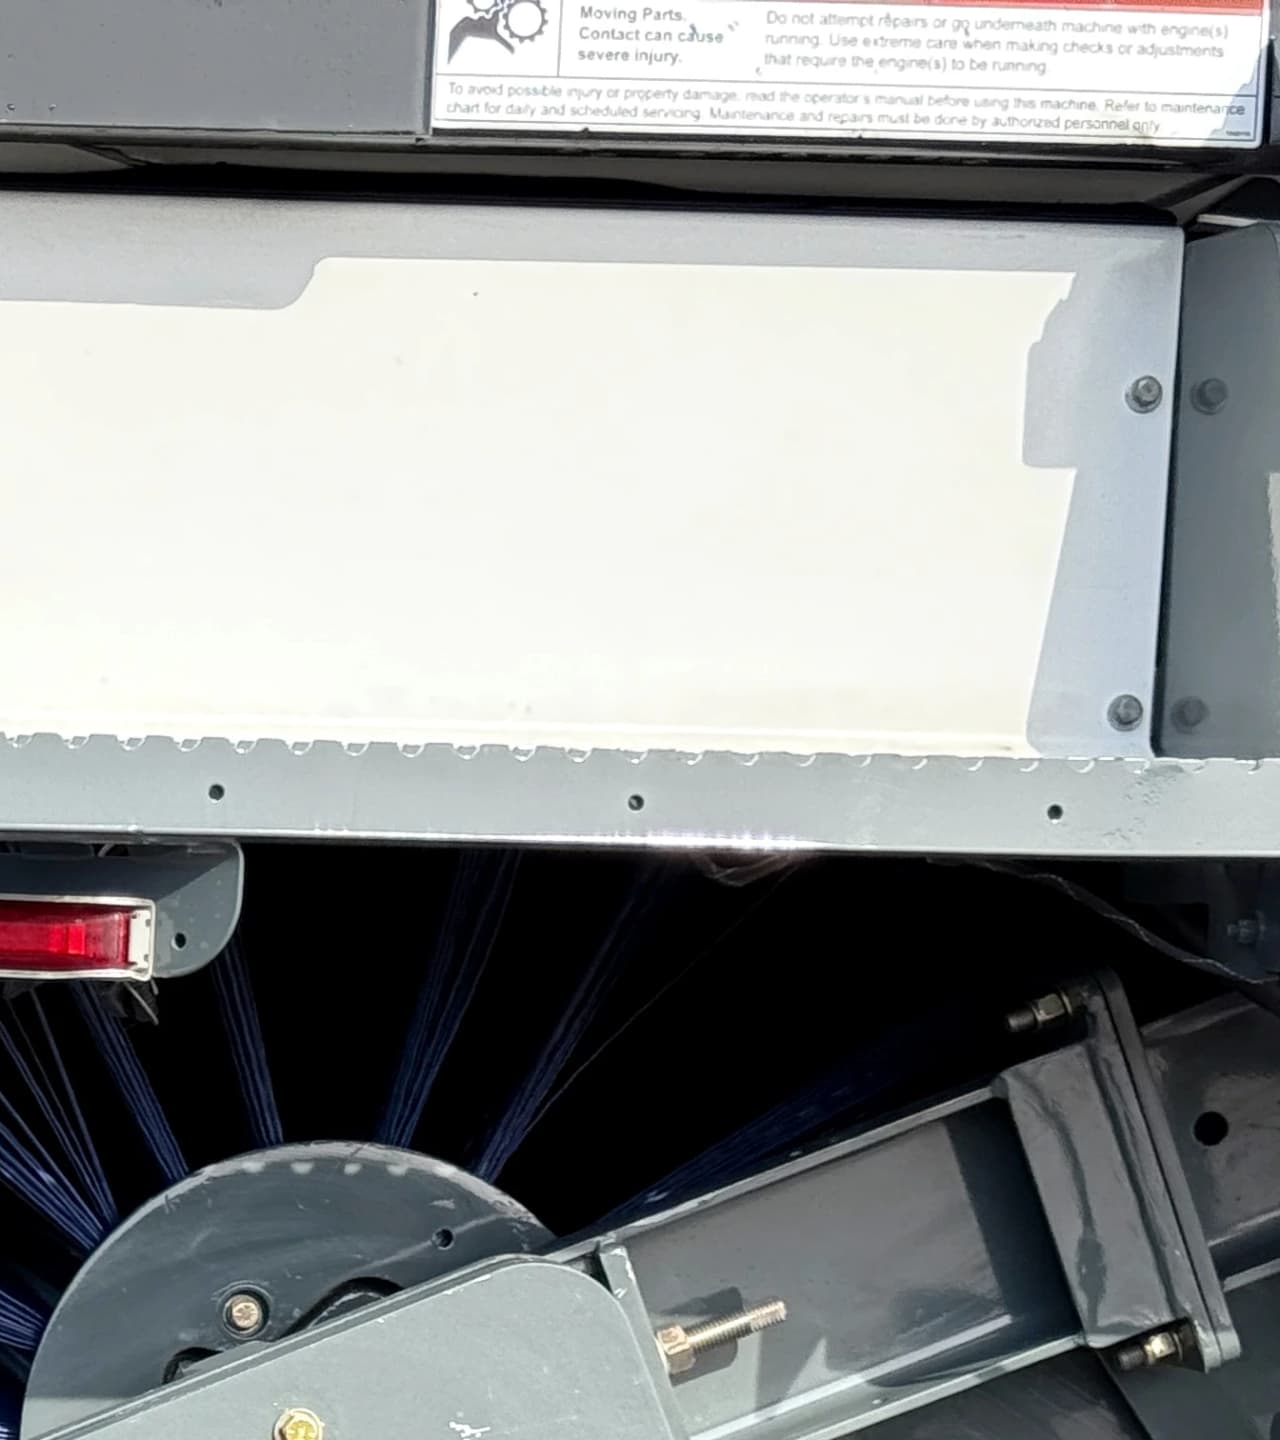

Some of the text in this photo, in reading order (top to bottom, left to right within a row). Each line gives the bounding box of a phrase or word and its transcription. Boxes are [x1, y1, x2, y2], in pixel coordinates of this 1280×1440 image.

[580, 6, 637, 23] Moving
[766, 10, 1228, 39] Do not attempt repairs or go underneath machine with engine(s)
[579, 26, 724, 43] Contact can cause
[829, 33, 858, 48] Use
[862, 35, 921, 49] extreme
[926, 38, 958, 50] care
[963, 37, 1001, 51] when
[1006, 40, 1059, 55] making
[1063, 41, 1113, 55] checks
[1118, 44, 1132, 55] or
[1137, 44, 1225, 59] adjustments
[578, 49, 683, 66] severe injury.
[764, 52, 791, 66] that
[796, 54, 847, 69] require
[851, 55, 874, 68] the
[878, 56, 947, 72] engine(s)
[952, 58, 965, 70] to
[969, 58, 988, 72] be
[448, 81, 463, 95] To
[467, 82, 504, 97] avoid
[508, 84, 562, 99] possible
[567, 86, 603, 101] injury
[606, 88, 620, 99] or
[624, 88, 679, 103] property
[745, 90, 775, 103] read
[780, 91, 801, 103] the
[875, 93, 924, 106] manual
[928, 94, 970, 107] before
[974, 96, 1010, 111] using
[1014, 96, 1037, 110] this
[1104, 99, 1141, 112] Refer
[1144, 100, 1157, 113] to
[1161, 101, 1246, 116] maintenance
[446, 100, 480, 115] chart
[484, 101, 502, 114] for
[505, 102, 536, 117] daily
[541, 103, 566, 116] and
[570, 104, 639, 118] scheduled
[710, 107, 795, 122] Maintenance
[799, 109, 824, 123] and
[828, 111, 873, 126] repairs
[877, 112, 910, 125] must
[913, 112, 930, 125] be
[934, 113, 968, 126] done
[971, 114, 987, 129] by
[991, 116, 1061, 130] authorized
[1064, 118, 1129, 133] personnel
